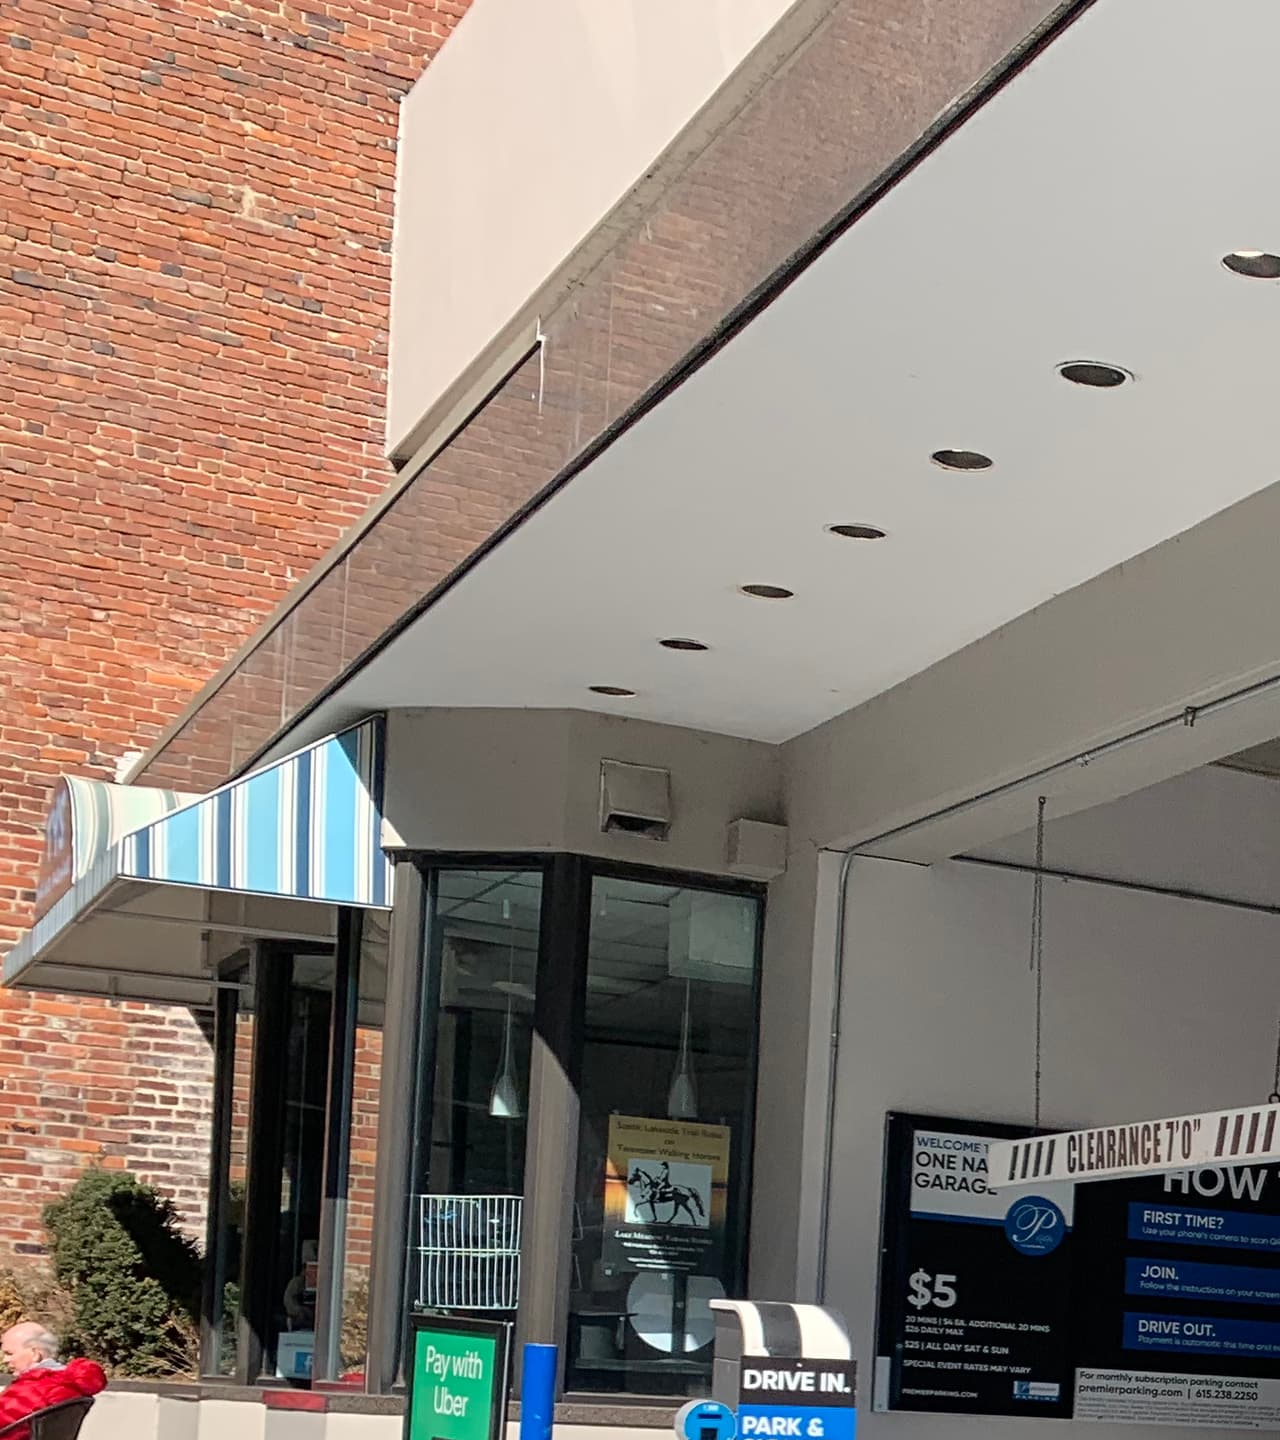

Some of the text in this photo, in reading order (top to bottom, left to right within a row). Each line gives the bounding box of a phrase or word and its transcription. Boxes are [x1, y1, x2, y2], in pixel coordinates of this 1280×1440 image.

[915, 1136, 981, 1153] WELCOME
[1067, 1122, 1161, 1174] CLEARANCE
[915, 1151, 957, 1171] ONE
[1164, 1166, 1268, 1201] HOW
[1143, 1210, 1224, 1229] FIRST TIME?
[1142, 1226, 1157, 1235] Use
[1158, 1228, 1176, 1237] your
[1209, 1233, 1239, 1242] camera
[1240, 1235, 1249, 1243] to
[1250, 1237, 1268, 1245] scan
[1141, 1265, 1179, 1280] JOIN.
[907, 1268, 957, 1310] $5
[1140, 1280, 1165, 1290] Follow
[1166, 1283, 1179, 1291] the
[1181, 1284, 1224, 1295] instructions
[1225, 1288, 1235, 1296] on
[1236, 1289, 1254, 1298] your
[1255, 1291, 1280, 1299] screen
[920, 1326, 945, 1335] DAILY
[945, 1327, 964, 1336] MAX
[968, 1320, 1017, 1330] ADDITIONAL
[1138, 1319, 1216, 1337] DRIVE OUT.
[926, 1341, 941, 1350] ALL
[943, 1343, 963, 1352] DAY
[964, 1344, 981, 1353] SAT
[991, 1346, 1009, 1355] SUN
[1137, 1335, 1173, 1345] Payment
[1182, 1338, 1221, 1347] automatic
[1238, 1341, 1255, 1350] time
[425, 1345, 483, 1382] Pay with
[903, 1359, 1031, 1374] SPECIAL EVENT RATES MAY VARY
[743, 1369, 851, 1393] DRIVE IN.
[1079, 1371, 1258, 1389] For monthly subscription parking contact
[433, 1385, 469, 1417] Uber
[1078, 1383, 1183, 1398] premierparking.com
[1196, 1389, 1258, 1401] 615.238.2250
[741, 1416, 825, 1437] PARK &
